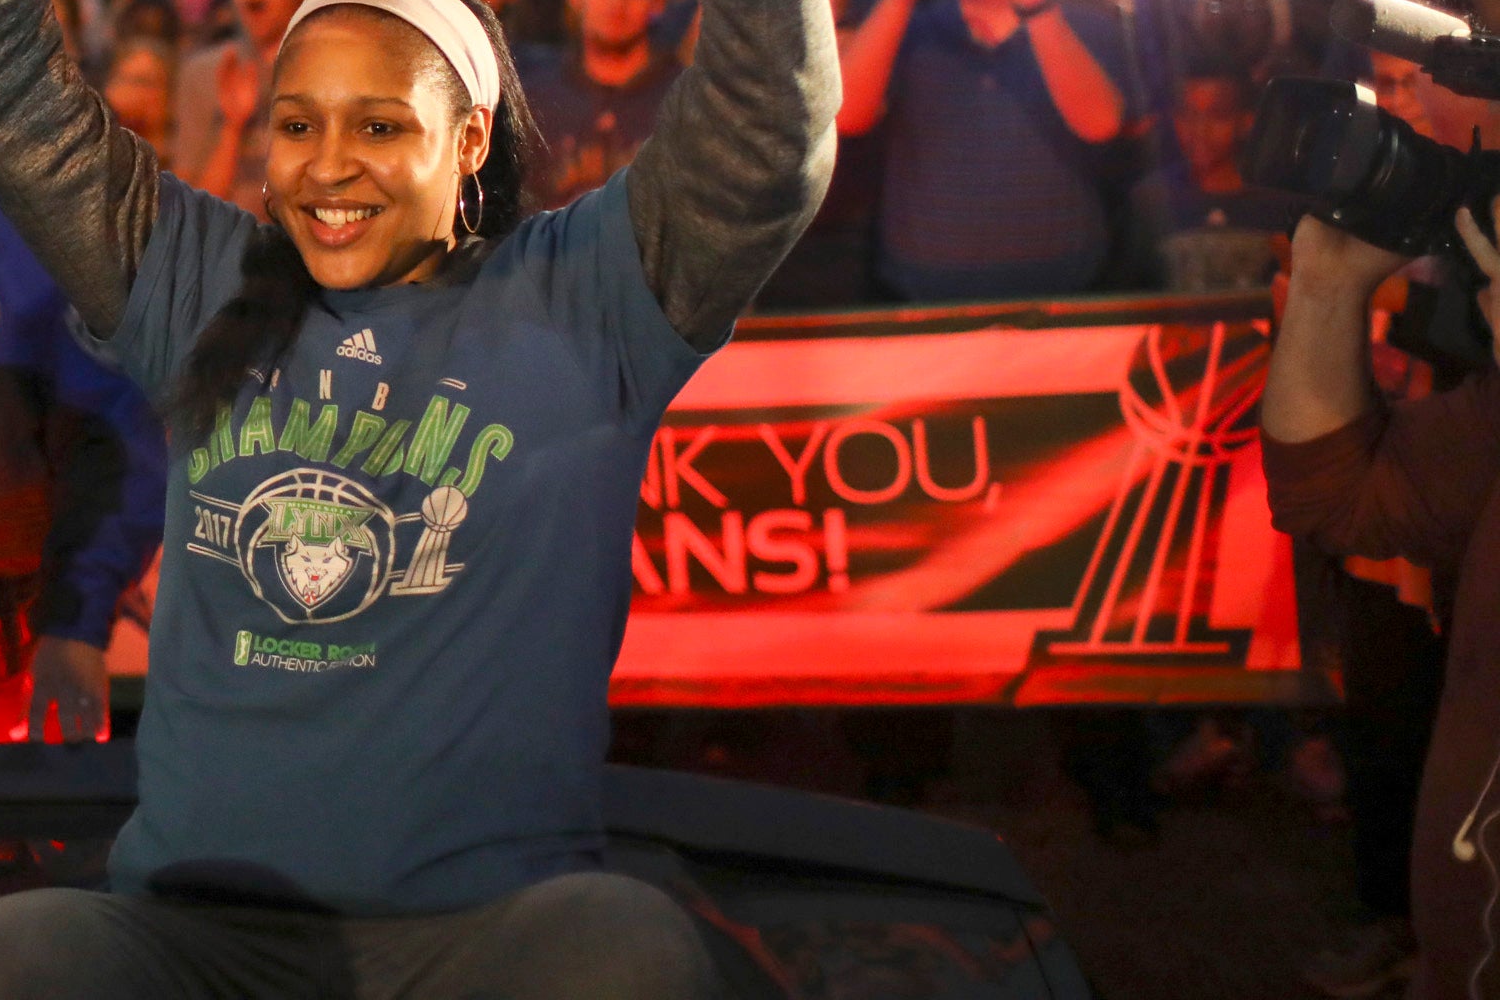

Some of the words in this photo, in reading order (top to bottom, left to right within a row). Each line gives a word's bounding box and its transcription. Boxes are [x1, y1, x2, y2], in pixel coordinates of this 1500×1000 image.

[336, 345, 383, 366] adidas
[756, 415, 1001, 514] YOU,
[287, 502, 353, 515] MINNESOTA
[194, 505, 231, 550] 2017
[271, 502, 367, 544] LYNX
[253, 635, 323, 660] LOCKER
[250, 652, 327, 673] AUTHENTIC
